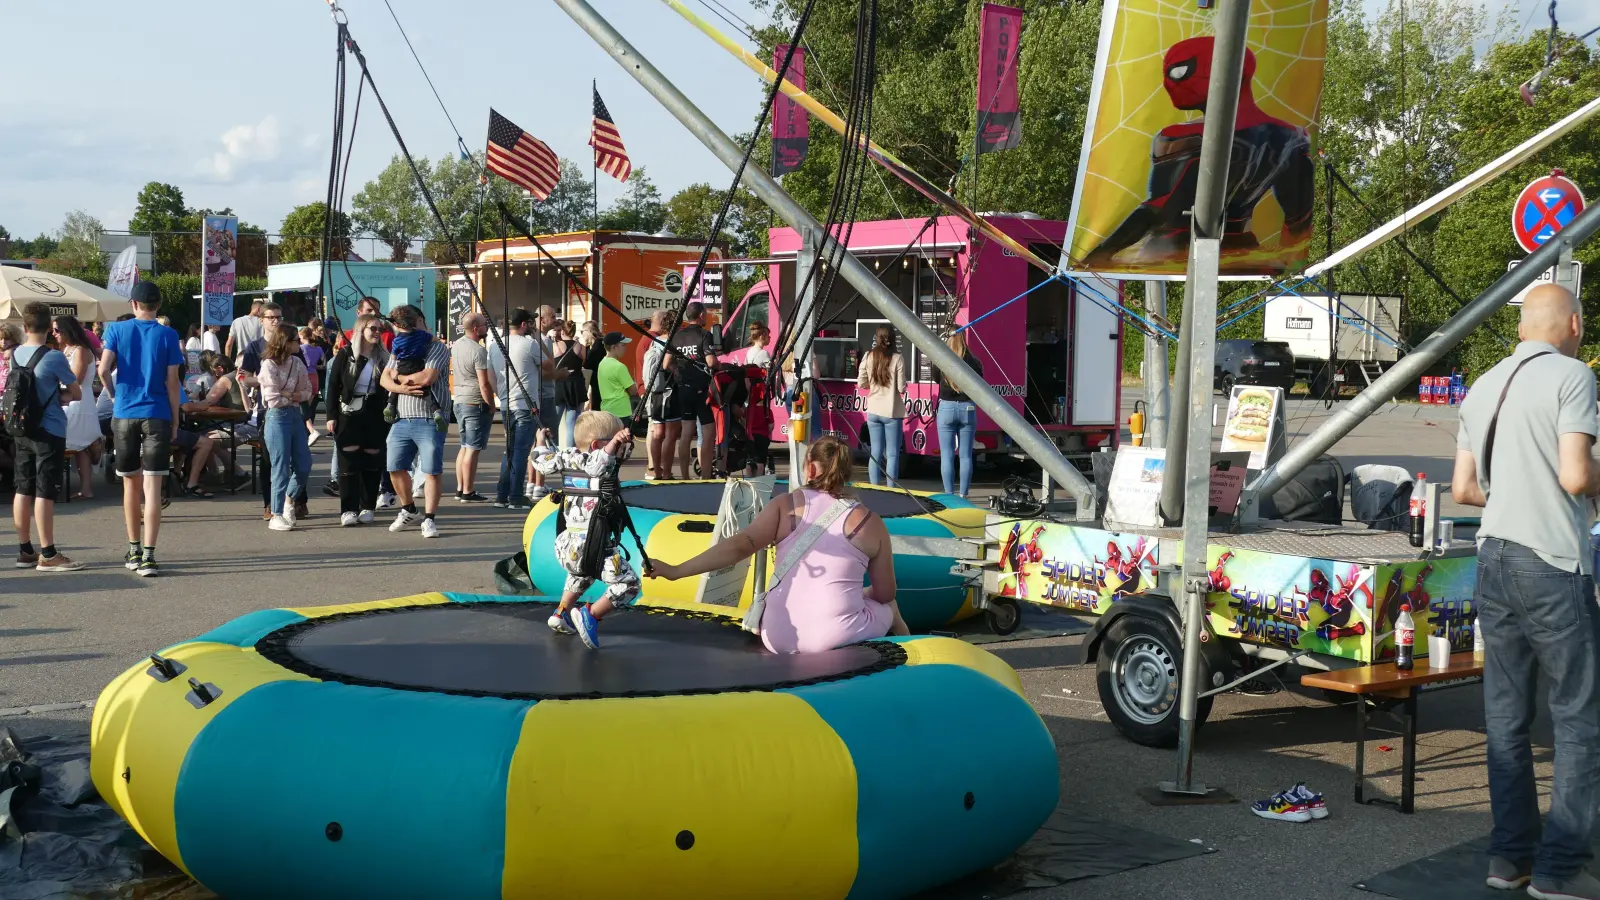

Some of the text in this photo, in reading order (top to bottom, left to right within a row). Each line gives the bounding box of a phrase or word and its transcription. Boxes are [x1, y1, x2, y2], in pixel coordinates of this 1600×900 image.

[49, 306, 76, 316] mann
[625, 294, 661, 311] STREET
[665, 297, 685, 311] FO
[1041, 555, 1107, 588] SPIDER
[1041, 582, 1099, 609] JUMPER
[1228, 585, 1310, 621] SPIDER
[1428, 597, 1477, 624] SPID
[1228, 614, 1299, 646] JUMPER
